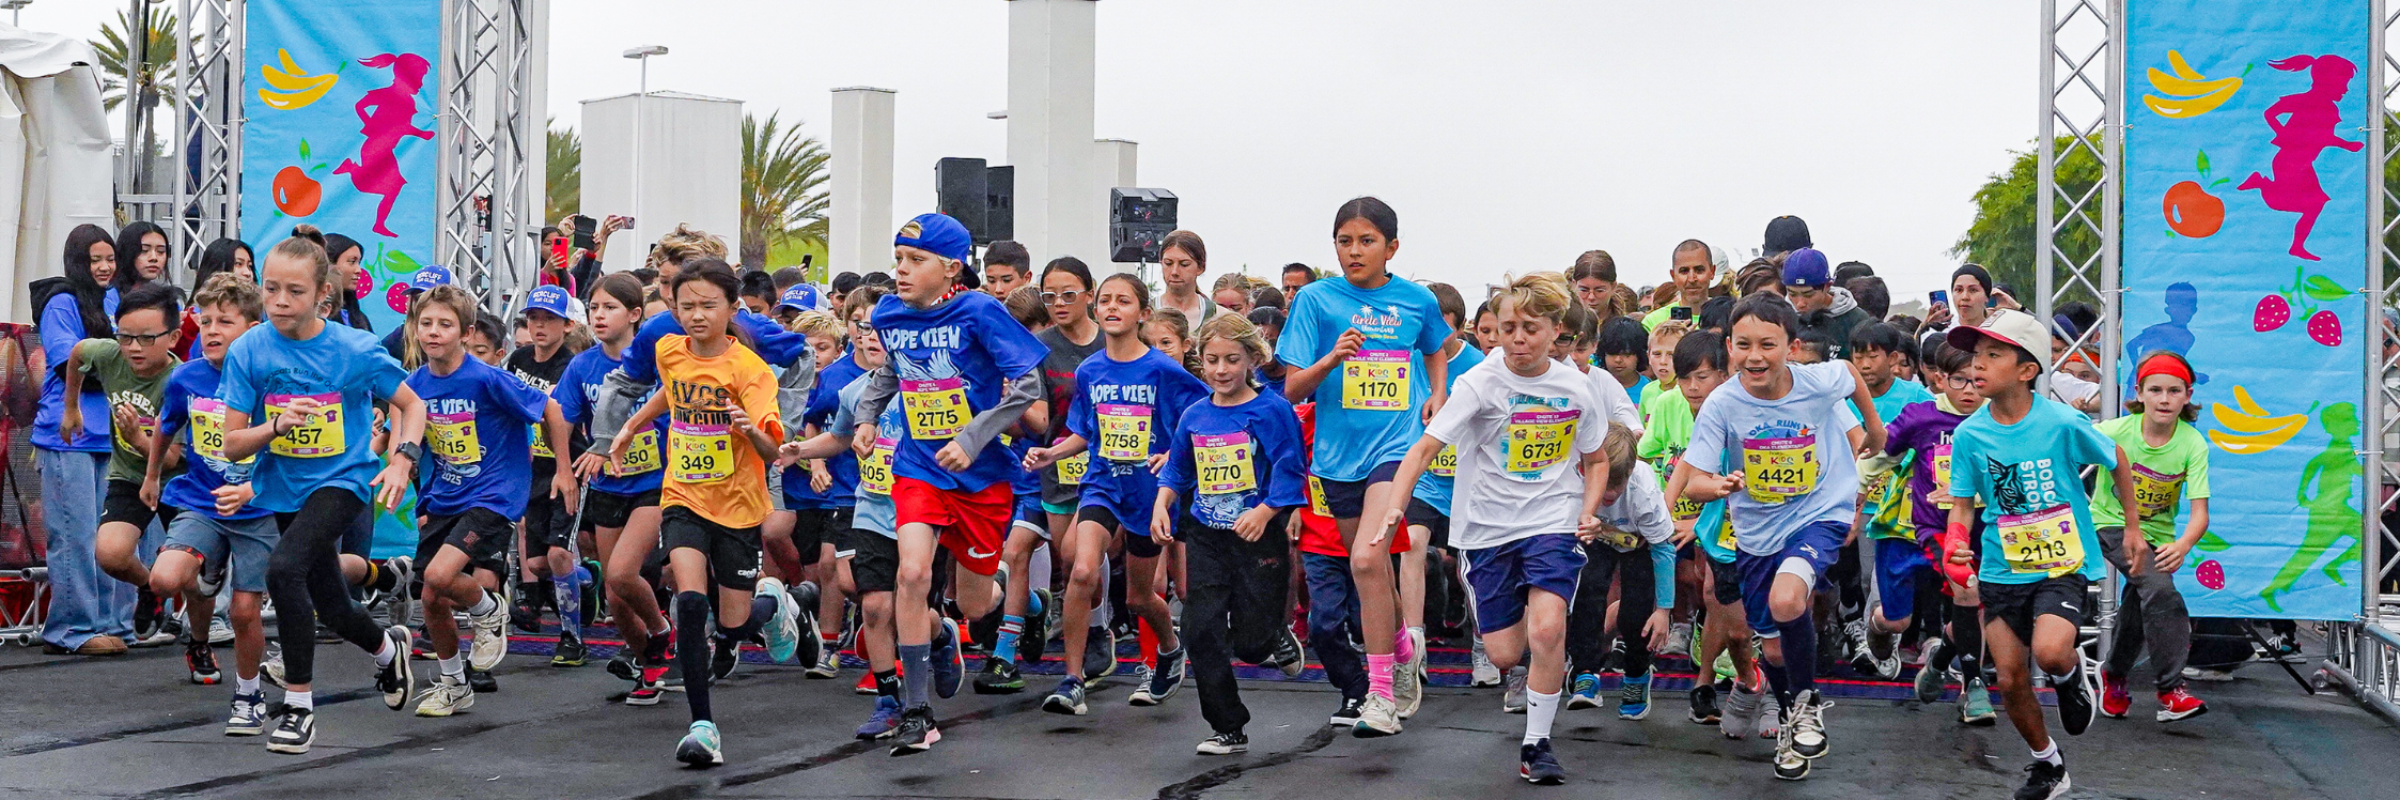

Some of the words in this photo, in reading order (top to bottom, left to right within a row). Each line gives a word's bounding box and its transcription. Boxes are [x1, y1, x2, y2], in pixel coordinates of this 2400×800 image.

[1352, 314, 1378, 326] Circle
[881, 328, 918, 352] HOPE
[921, 325, 960, 349] VIEW
[514, 367, 550, 390] ESULTS
[582, 382, 600, 402] HO
[1089, 384, 1119, 404] HOPE
[1122, 384, 1156, 405] VIEW
[1358, 382, 1398, 397] 1170
[422, 399, 438, 414] PE
[917, 410, 958, 427] 2775
[285, 428, 322, 444] 457
[1749, 422, 1772, 436] OKA
[1776, 420, 1801, 430] RUNS
[1106, 433, 1139, 448] 2758
[1522, 440, 1562, 459] 6731
[681, 455, 715, 470] 349
[442, 472, 462, 486] 2025
[1204, 464, 1241, 482] 2770
[1758, 468, 1804, 484] 4421
[2020, 460, 2040, 511] STRON
[2036, 458, 2060, 509] BOBCA
[2136, 489, 2173, 502] 3135
[2020, 540, 2066, 563] 2113
